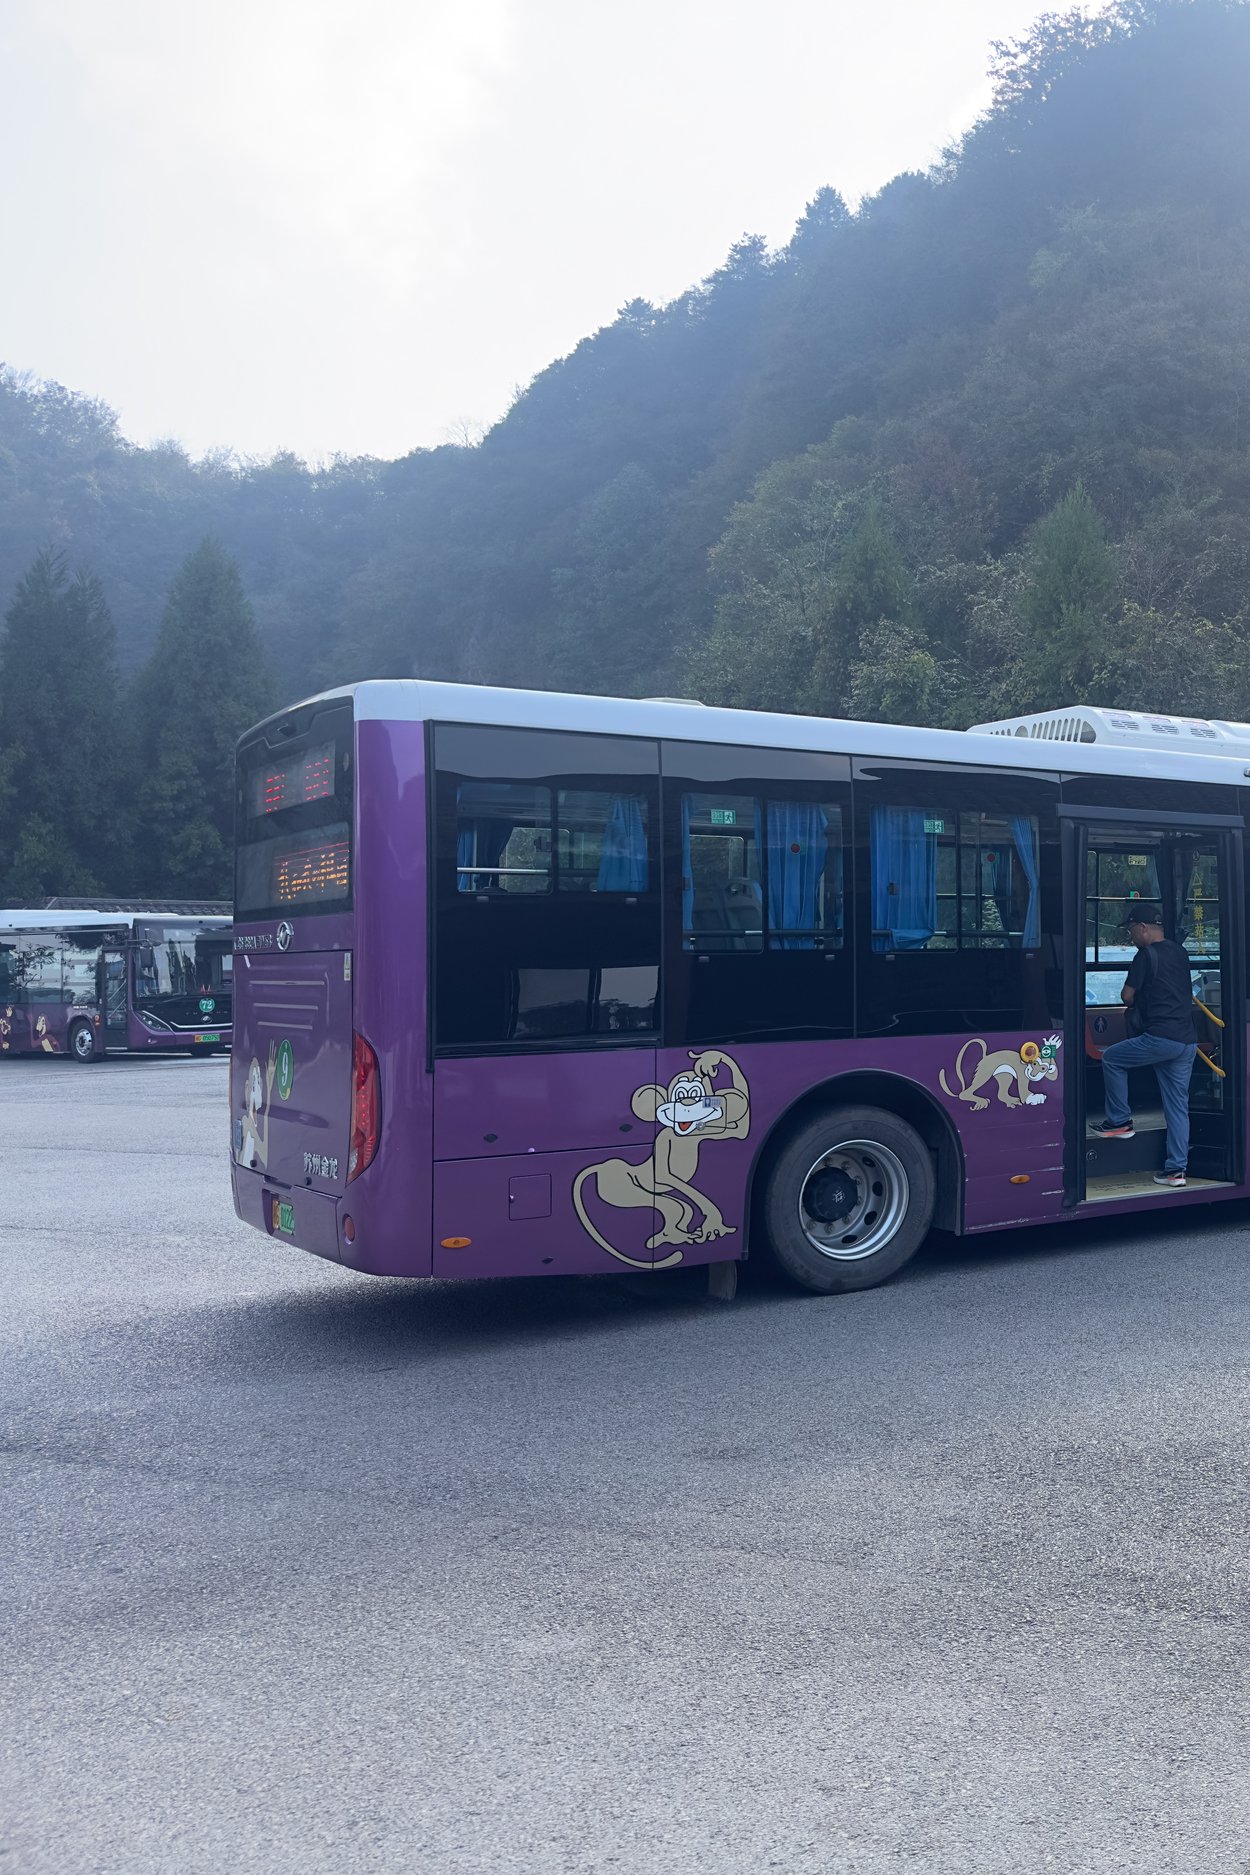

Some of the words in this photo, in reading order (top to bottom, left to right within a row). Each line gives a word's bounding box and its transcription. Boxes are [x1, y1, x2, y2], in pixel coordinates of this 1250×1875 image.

[201, 1000, 213, 1009] 72
[281, 1052, 289, 1086] 9
[303, 1151, 338, 1180] 苏州金龙
